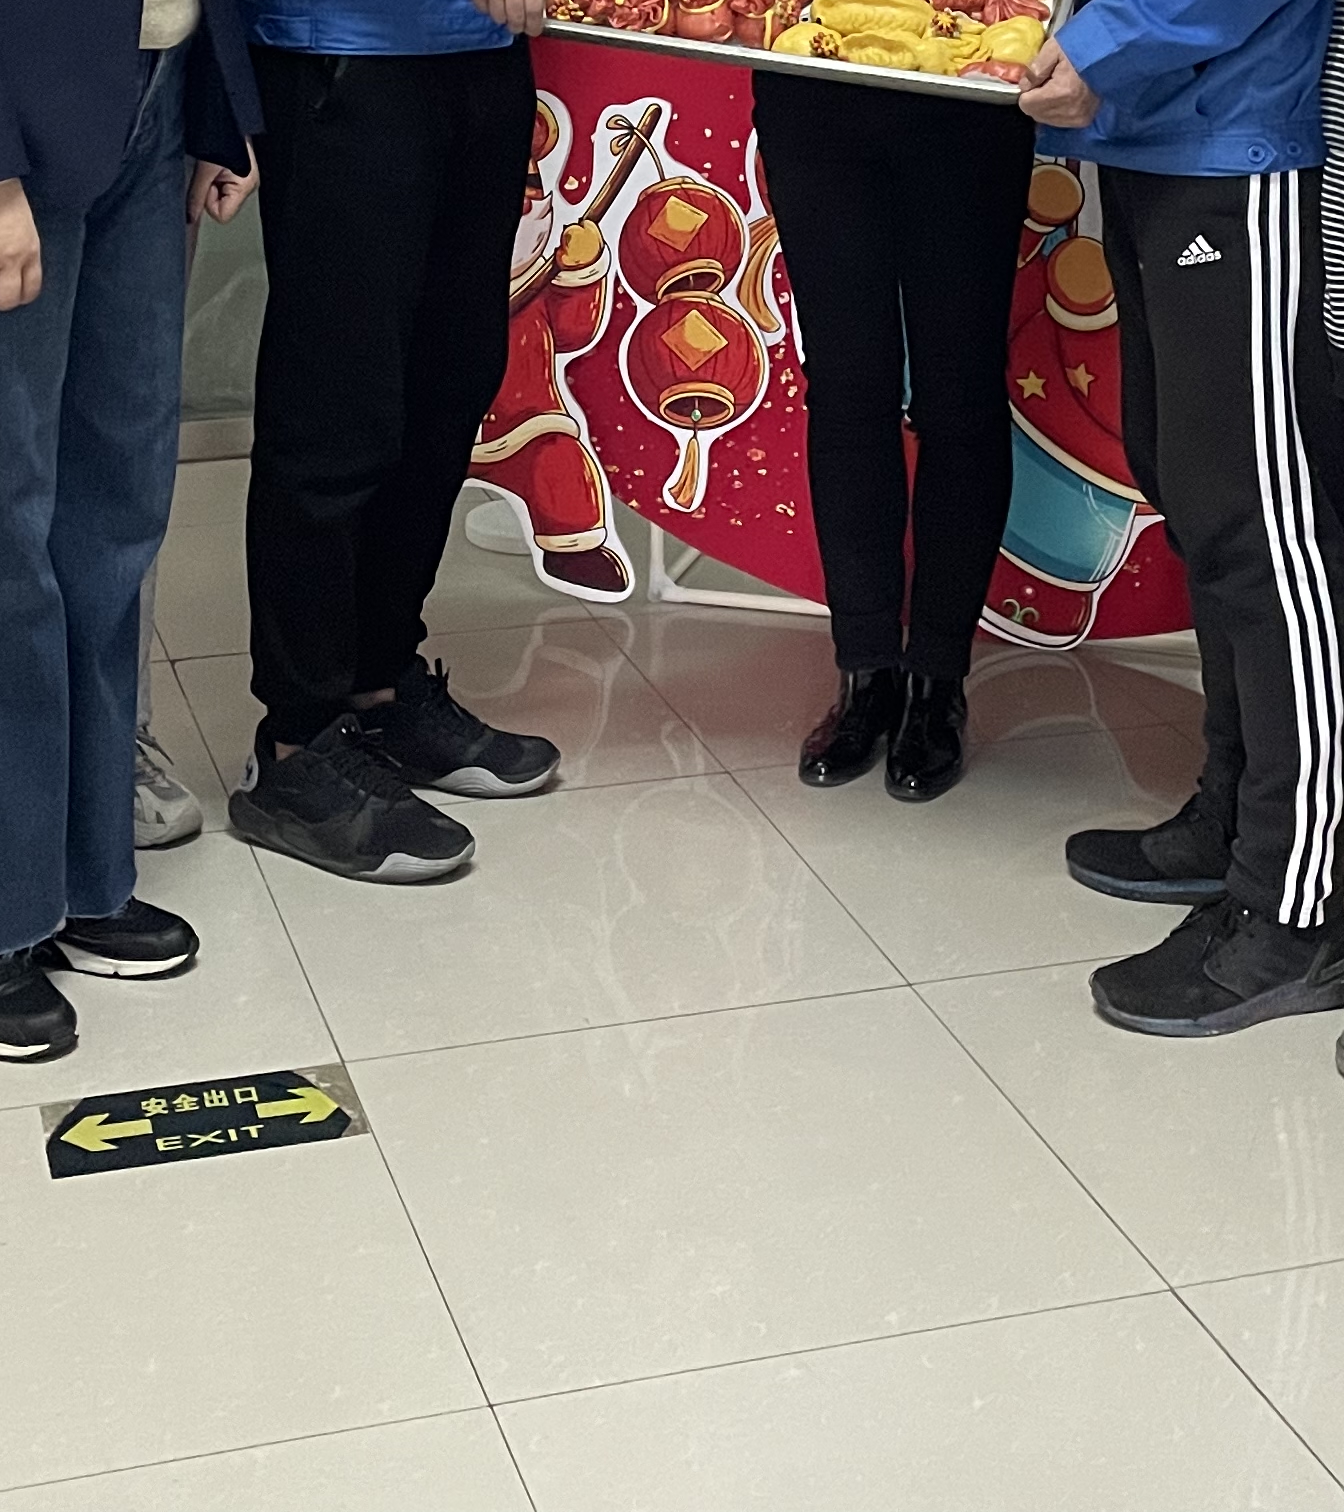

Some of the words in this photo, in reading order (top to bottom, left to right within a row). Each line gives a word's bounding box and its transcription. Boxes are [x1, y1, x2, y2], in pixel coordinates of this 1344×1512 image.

[1177, 250, 1222, 266] adidas
[140, 1086, 259, 1118] 安全出口
[155, 1124, 265, 1152] EXIT
